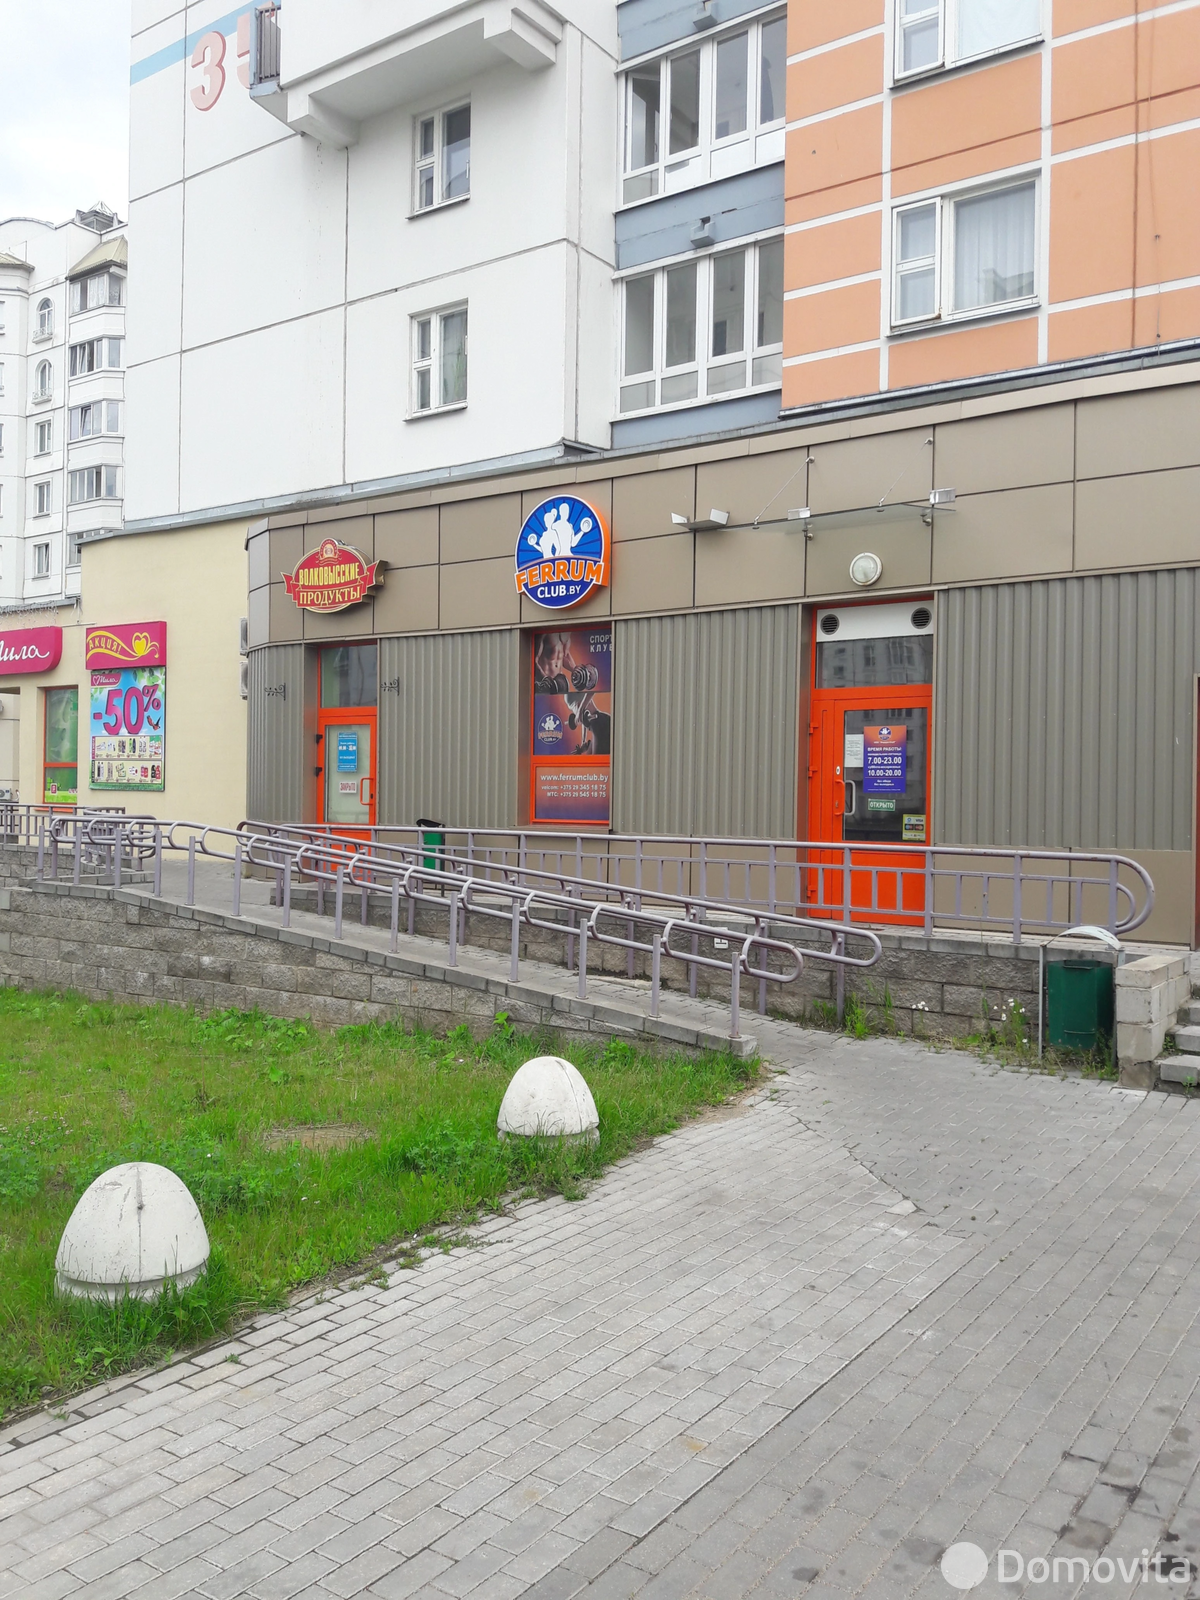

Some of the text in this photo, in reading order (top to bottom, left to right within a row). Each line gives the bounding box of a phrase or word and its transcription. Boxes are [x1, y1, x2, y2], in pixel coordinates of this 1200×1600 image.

[299, 562, 359, 586] ВОЛКОВЫССКИЕ
[514, 559, 604, 594] FERRUM
[299, 586, 361, 607] ПРОДУКТЫ
[537, 584, 581, 598] CLUB.BY
[89, 637, 122, 654] АКЦИЯ!
[93, 684, 162, 736] -50%
[540, 773, 608, 782] www.ferrumclub.by
